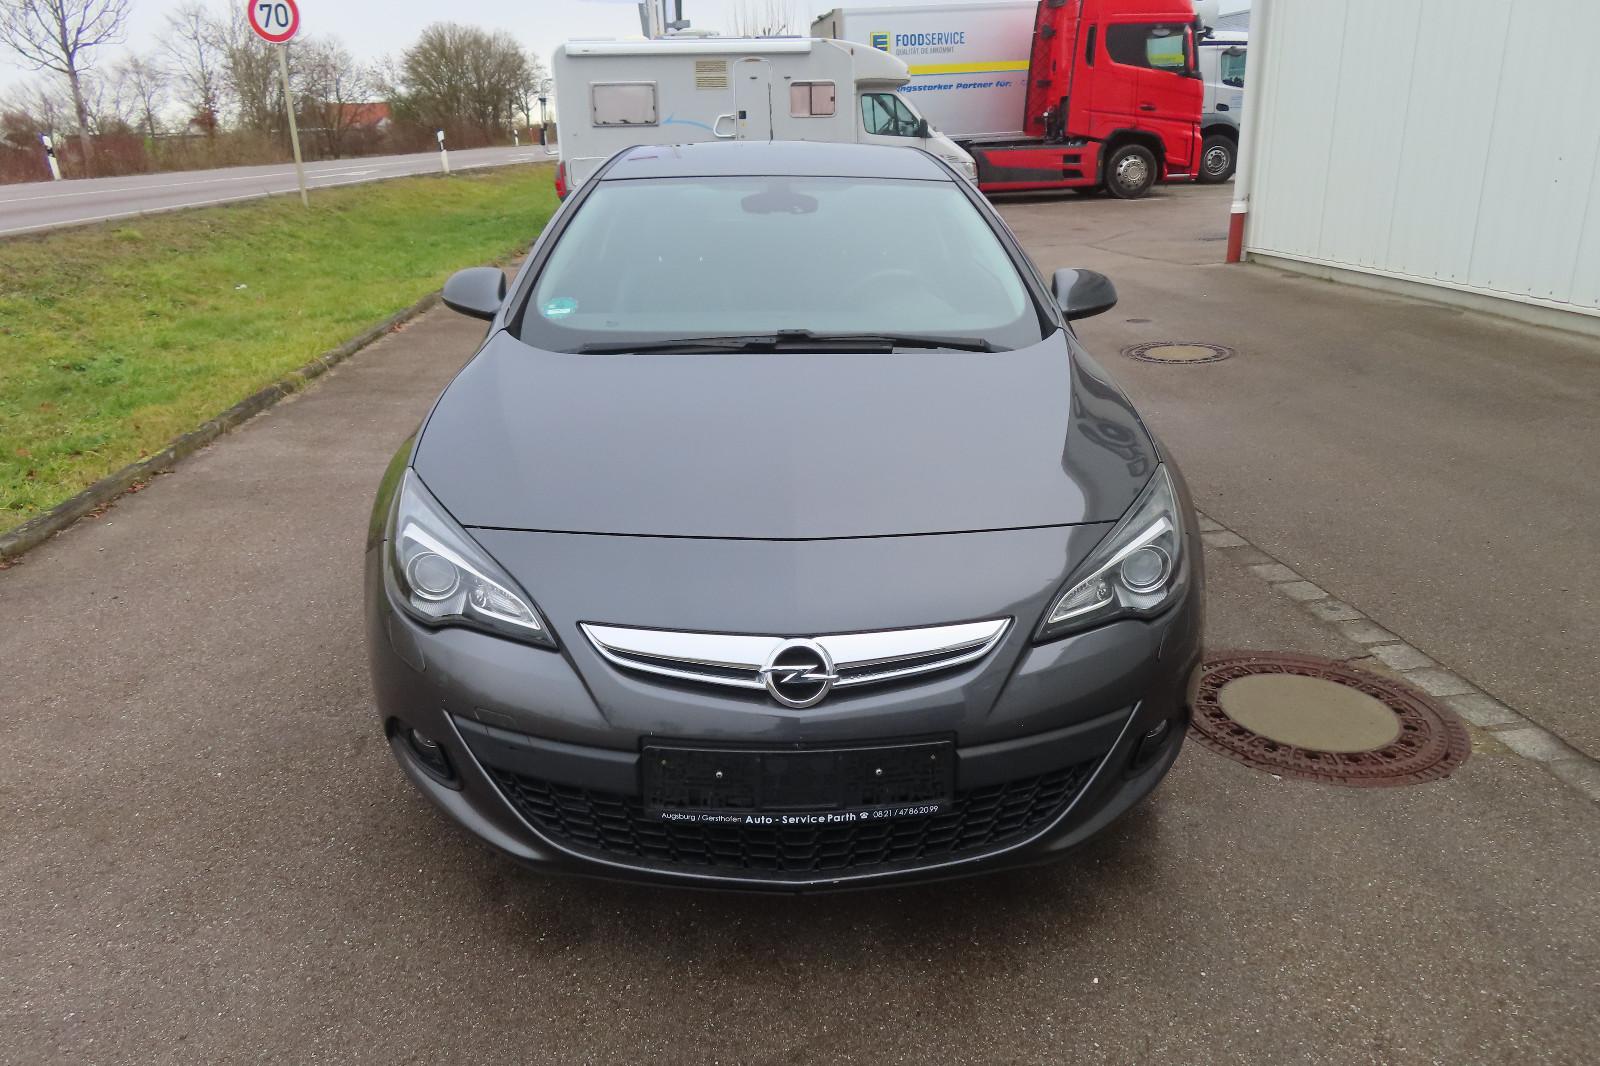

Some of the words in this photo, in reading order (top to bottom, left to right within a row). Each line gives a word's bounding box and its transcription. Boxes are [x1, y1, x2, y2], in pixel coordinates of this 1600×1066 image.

[259, 3, 289, 28] 70
[896, 32, 965, 47] FOODSERVICE
[956, 81, 993, 89] Partner
[661, 812, 696, 822] Augsburg
[702, 814, 742, 823] Gersthofen
[745, 815, 773, 824] Auto
[782, 814, 825, 824] Service
[827, 813, 856, 822] Parth
[873, 809, 892, 818] 0821
